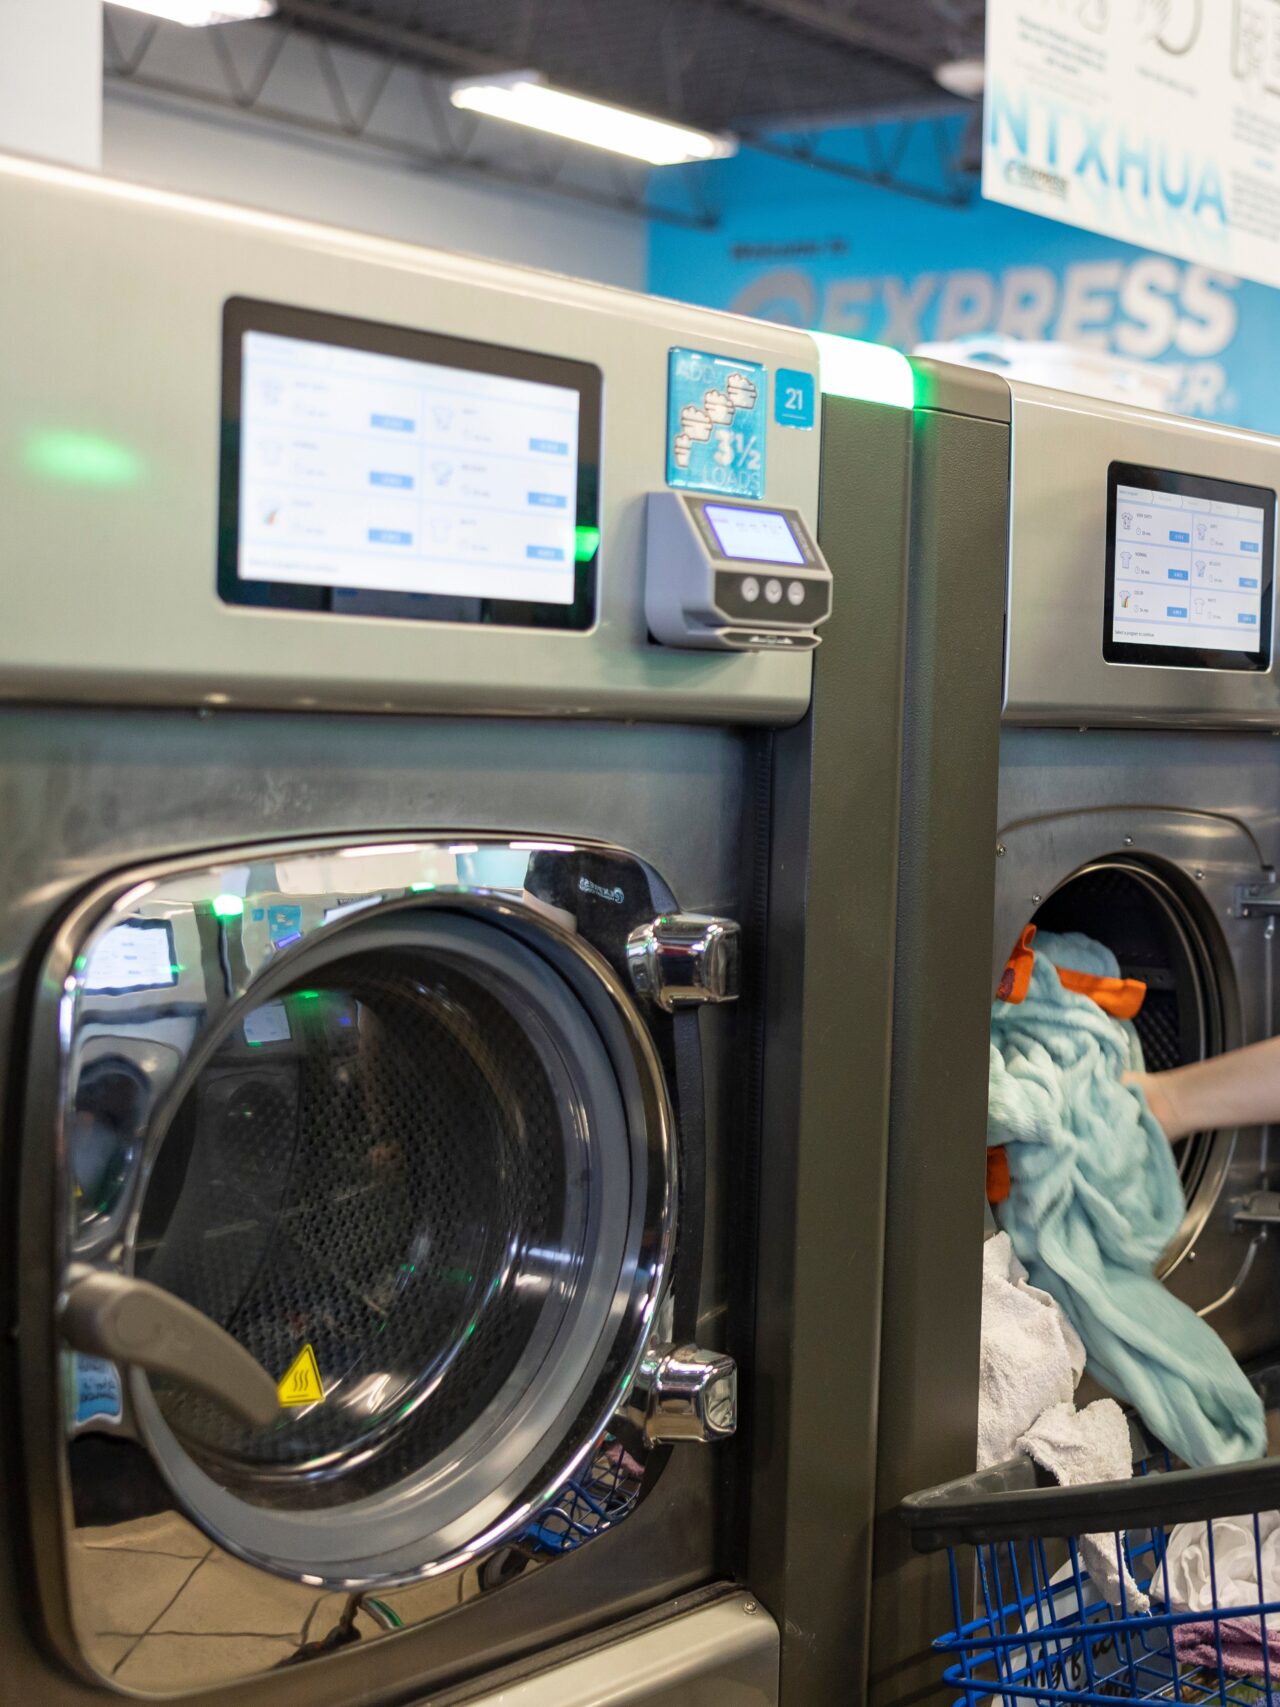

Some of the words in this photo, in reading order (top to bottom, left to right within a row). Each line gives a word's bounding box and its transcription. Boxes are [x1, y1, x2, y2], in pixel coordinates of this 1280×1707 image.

[821, 256, 1240, 358] EXPRESS
[784, 387, 804, 411] 21
[703, 465, 761, 490] LOADS
